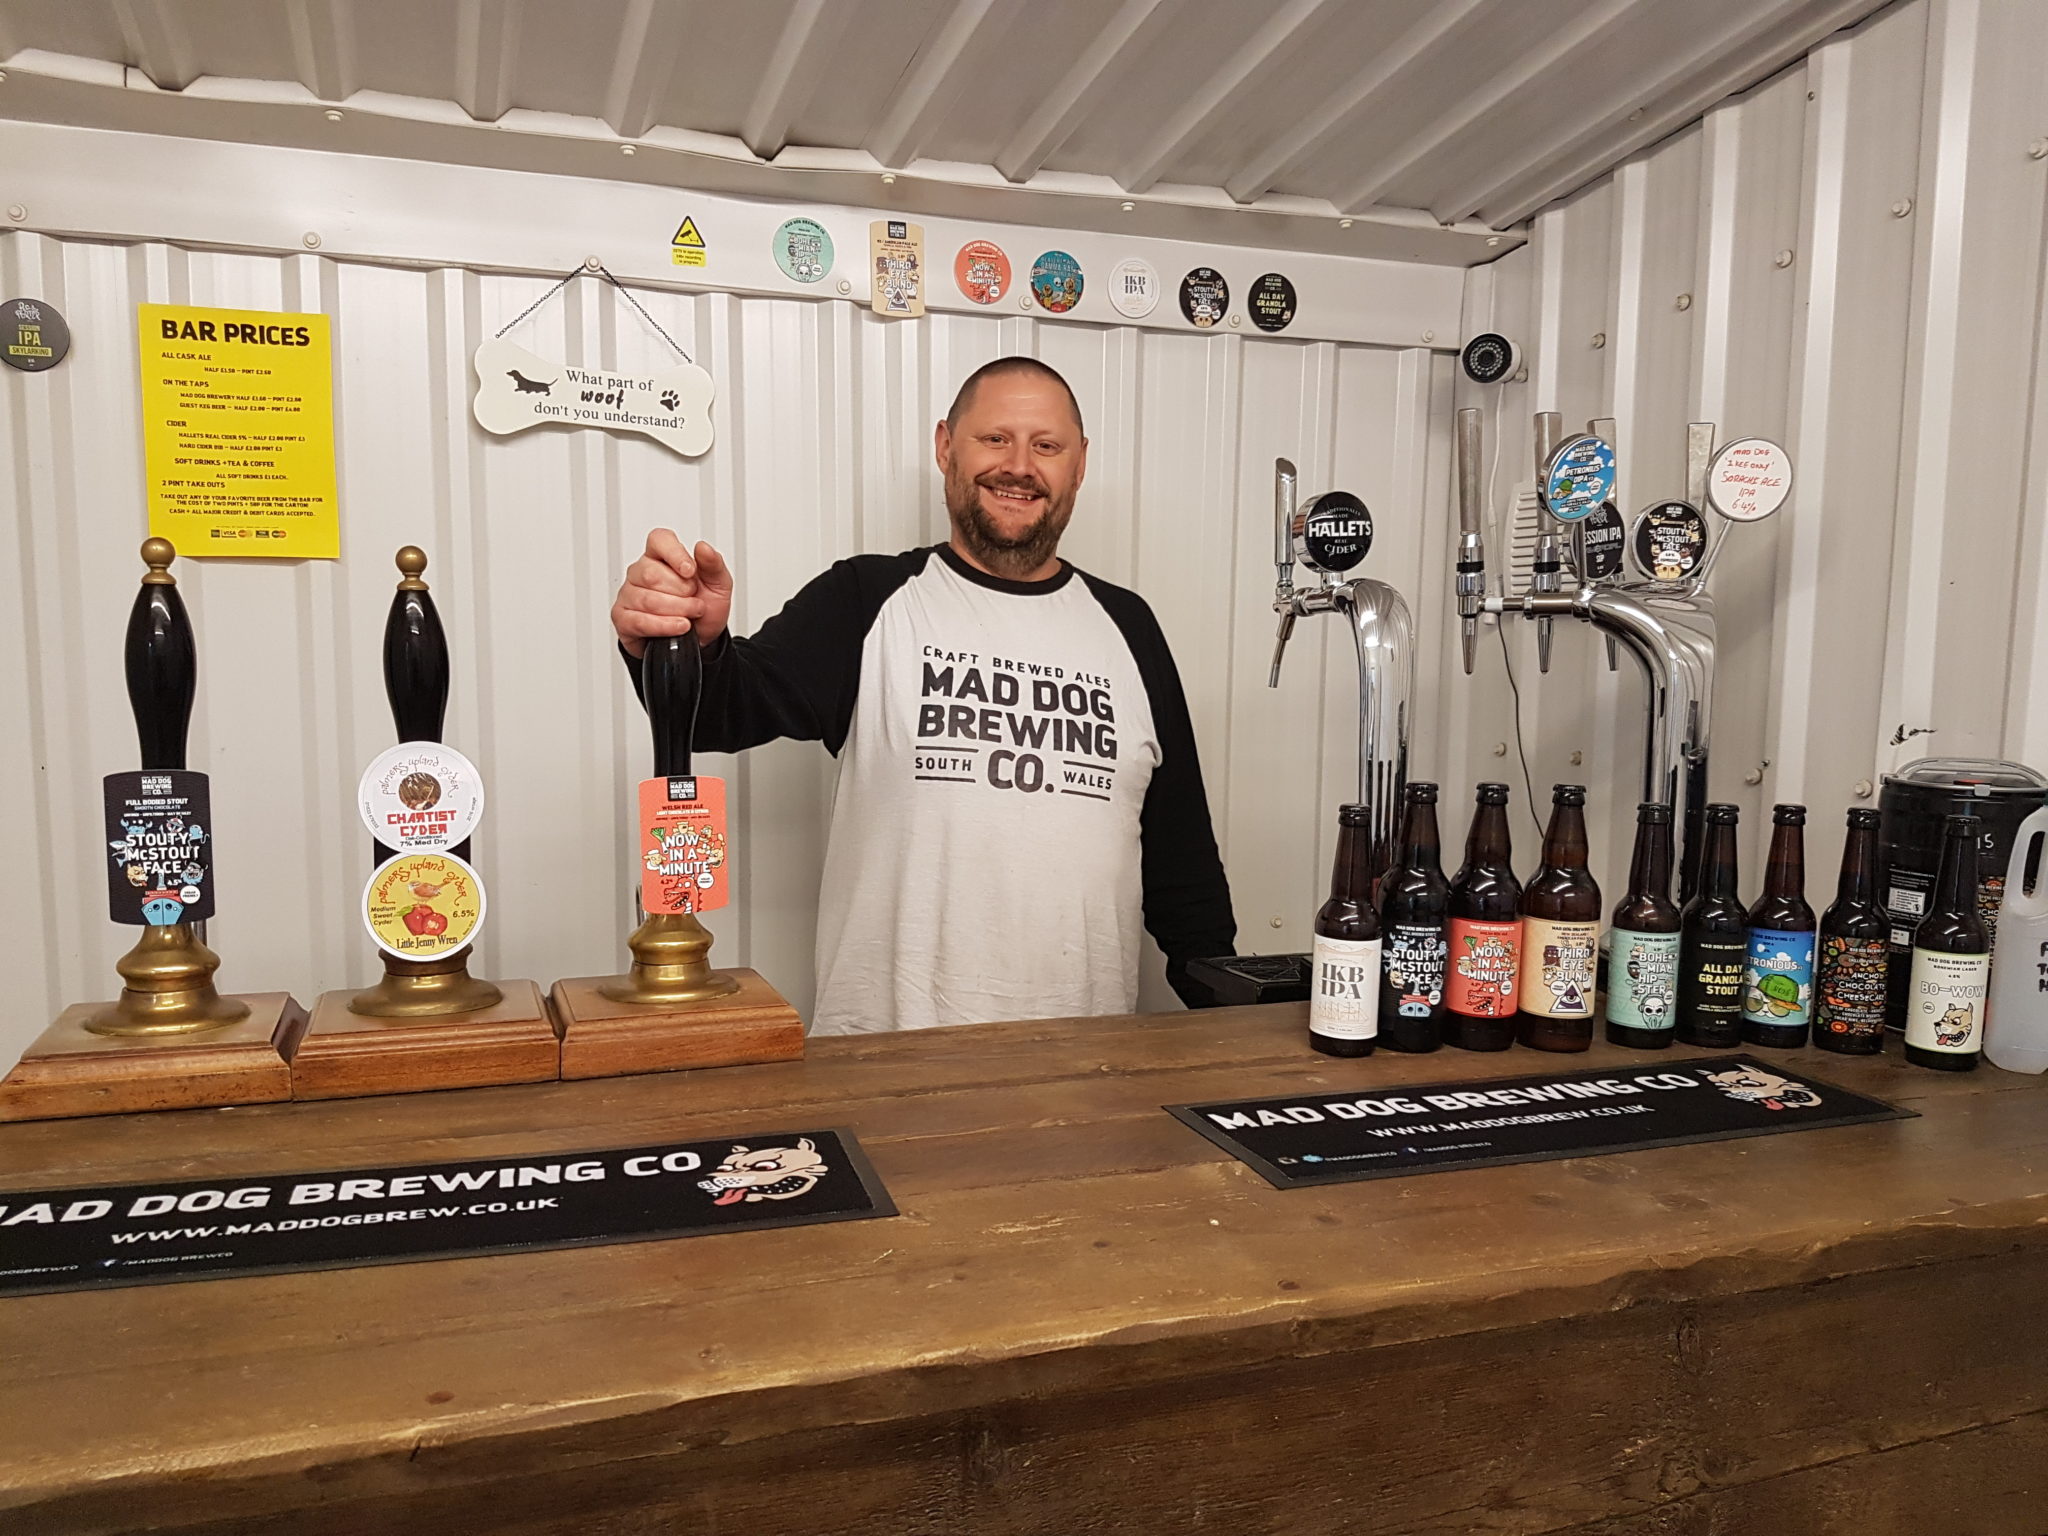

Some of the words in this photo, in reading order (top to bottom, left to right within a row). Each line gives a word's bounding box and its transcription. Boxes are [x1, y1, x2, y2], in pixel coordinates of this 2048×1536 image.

[885, 260, 911, 269] THIRD
[891, 270, 906, 279] EYE
[1125, 276, 1145, 285] IKB
[887, 280, 912, 289] BLIND
[1125, 285, 1145, 294] IPA
[19, 331, 41, 345] IPA
[161, 319, 217, 342] BAR
[224, 323, 310, 346] PRICES
[175, 379, 188, 387] THE
[189, 380, 209, 388] TAPS
[566, 370, 602, 386] What
[607, 377, 634, 390] part
[638, 379, 654, 391] of
[580, 389, 624, 409] woof
[534, 402, 568, 416] don't
[573, 408, 599, 420] you
[604, 412, 685, 429] understand?
[1566, 465, 1600, 475] PETRONIUS
[1761, 477, 1781, 486] ACE
[1739, 488, 1756, 497] IPA
[1308, 521, 1371, 537] HALLETS
[1609, 527, 1621, 540] IPA
[1657, 527, 1685, 535] STOUTY
[1325, 544, 1357, 559] CIDER
[923, 645, 979, 665] CRAFT
[993, 657, 1064, 678] BREWED
[1075, 672, 1111, 689] ALES
[922, 662, 1020, 707] MAD
[1032, 680, 1115, 723] DOG
[917, 704, 1118, 760] BREWING
[915, 757, 972, 771] SOUTH
[987, 750, 1055, 793] CO.
[1064, 771, 1112, 790] WALES
[387, 810, 456, 825] CHARTIST
[400, 823, 447, 837] CYDER
[126, 832, 189, 847] STOUTY
[665, 834, 700, 847] NOW
[669, 849, 683, 861] IN
[688, 849, 698, 860] A
[143, 861, 182, 874] FACE
[659, 862, 711, 876] MINUTE
[453, 909, 475, 918] 6.5%
[397, 938, 414, 949] Little
[415, 937, 435, 949] Jenny
[437, 934, 458, 945] Wren
[1392, 948, 1439, 960] STOUTY
[1476, 947, 1505, 957] NOW
[1557, 948, 1590, 958] THIRD
[1478, 959, 1490, 968] IN
[1494, 959, 1501, 968] A
[1563, 961, 1584, 970] EYE
[1703, 964, 1723, 973] ALL
[1726, 964, 1743, 973] DAY
[1748, 956, 1797, 969] TRONIOUS
[1322, 963, 1364, 982] IKB
[1403, 972, 1431, 984] FACE
[1468, 970, 1510, 981] MINUTE
[1557, 972, 1589, 982] BLIND
[1698, 974, 1743, 984] GRANOLA
[1321, 979, 1362, 999] IPA
[1638, 984, 1666, 994] STER
[1706, 986, 1739, 995] STOUT
[1209, 1110, 1325, 1130] MAD
[1323, 1097, 1430, 1119] DOG
[1422, 1077, 1642, 1112] BREWING
[1634, 1073, 1699, 1090] CO
[0, 1199, 113, 1226] AD
[127, 1186, 271, 1217] DOG
[288, 1161, 605, 1206] BREWING
[623, 1151, 702, 1177] CO
[111, 1197, 559, 1245] WWW.MADDOGBREW.CO.UK
